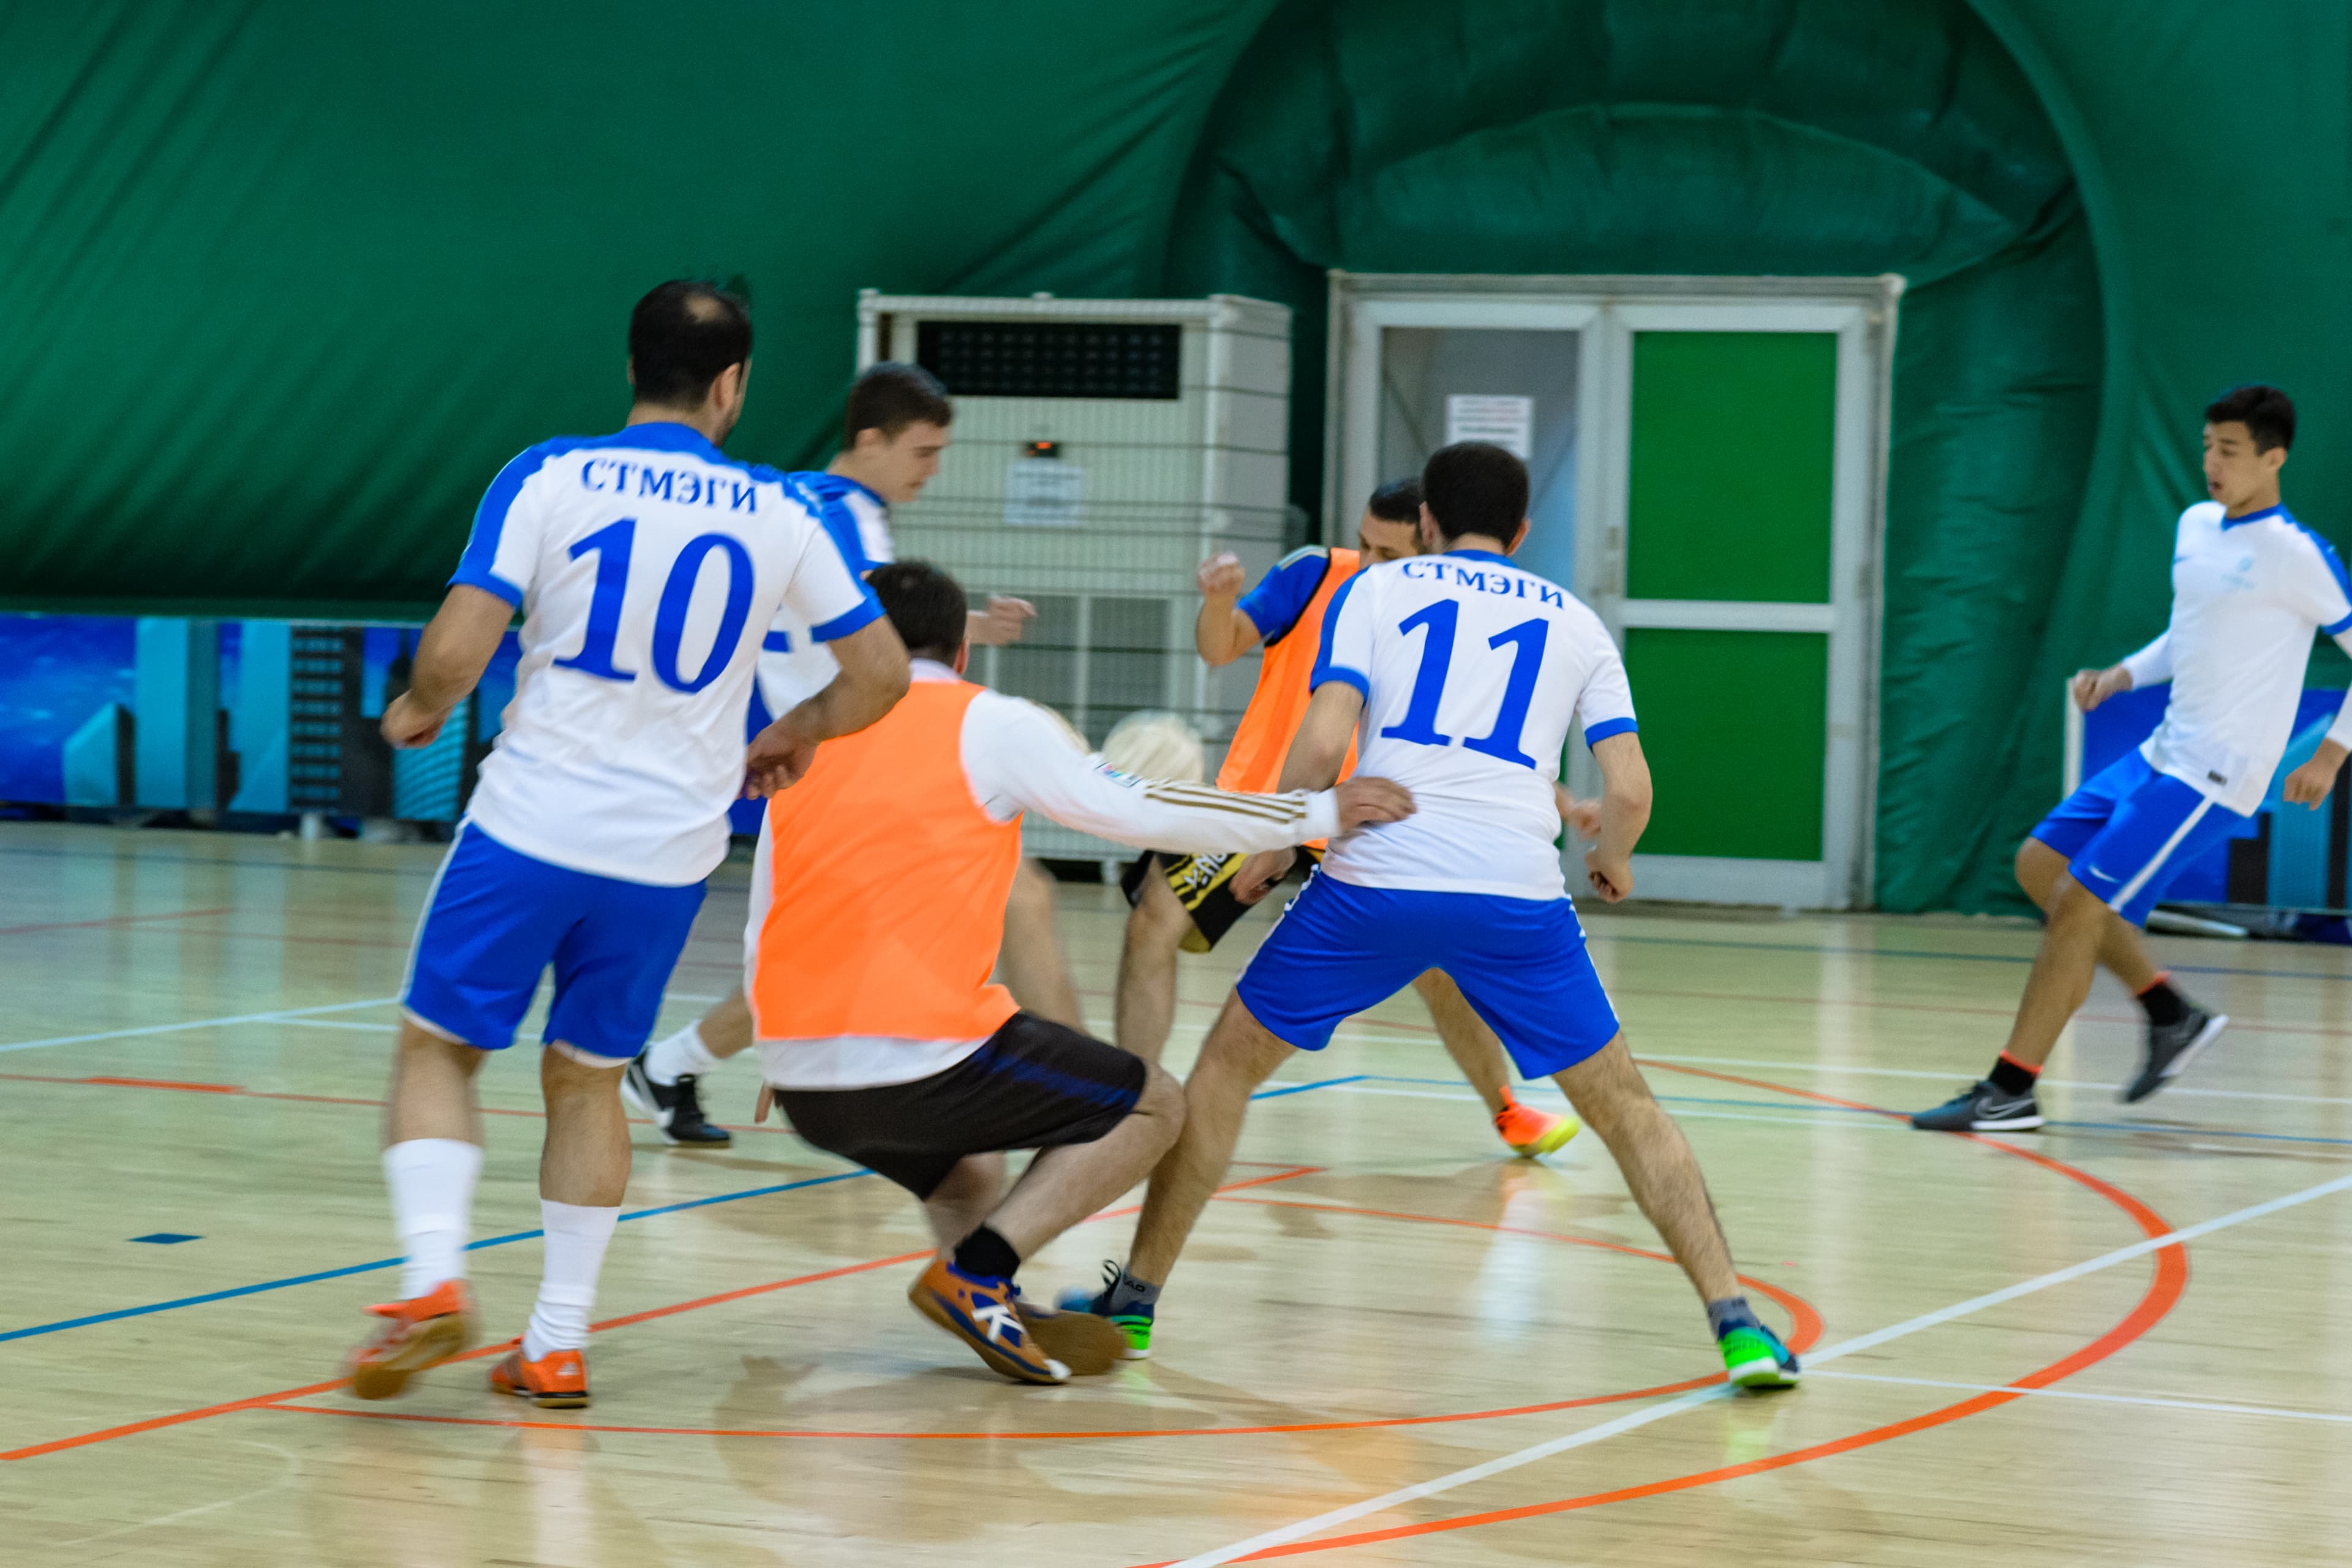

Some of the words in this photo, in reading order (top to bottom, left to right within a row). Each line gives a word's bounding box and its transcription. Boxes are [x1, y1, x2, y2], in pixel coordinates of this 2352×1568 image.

[581, 458, 760, 513] СТМЭГИ
[554, 516, 755, 695] 10
[1403, 561, 1565, 610] СТМЭГИ
[1381, 598, 1549, 771] 11
